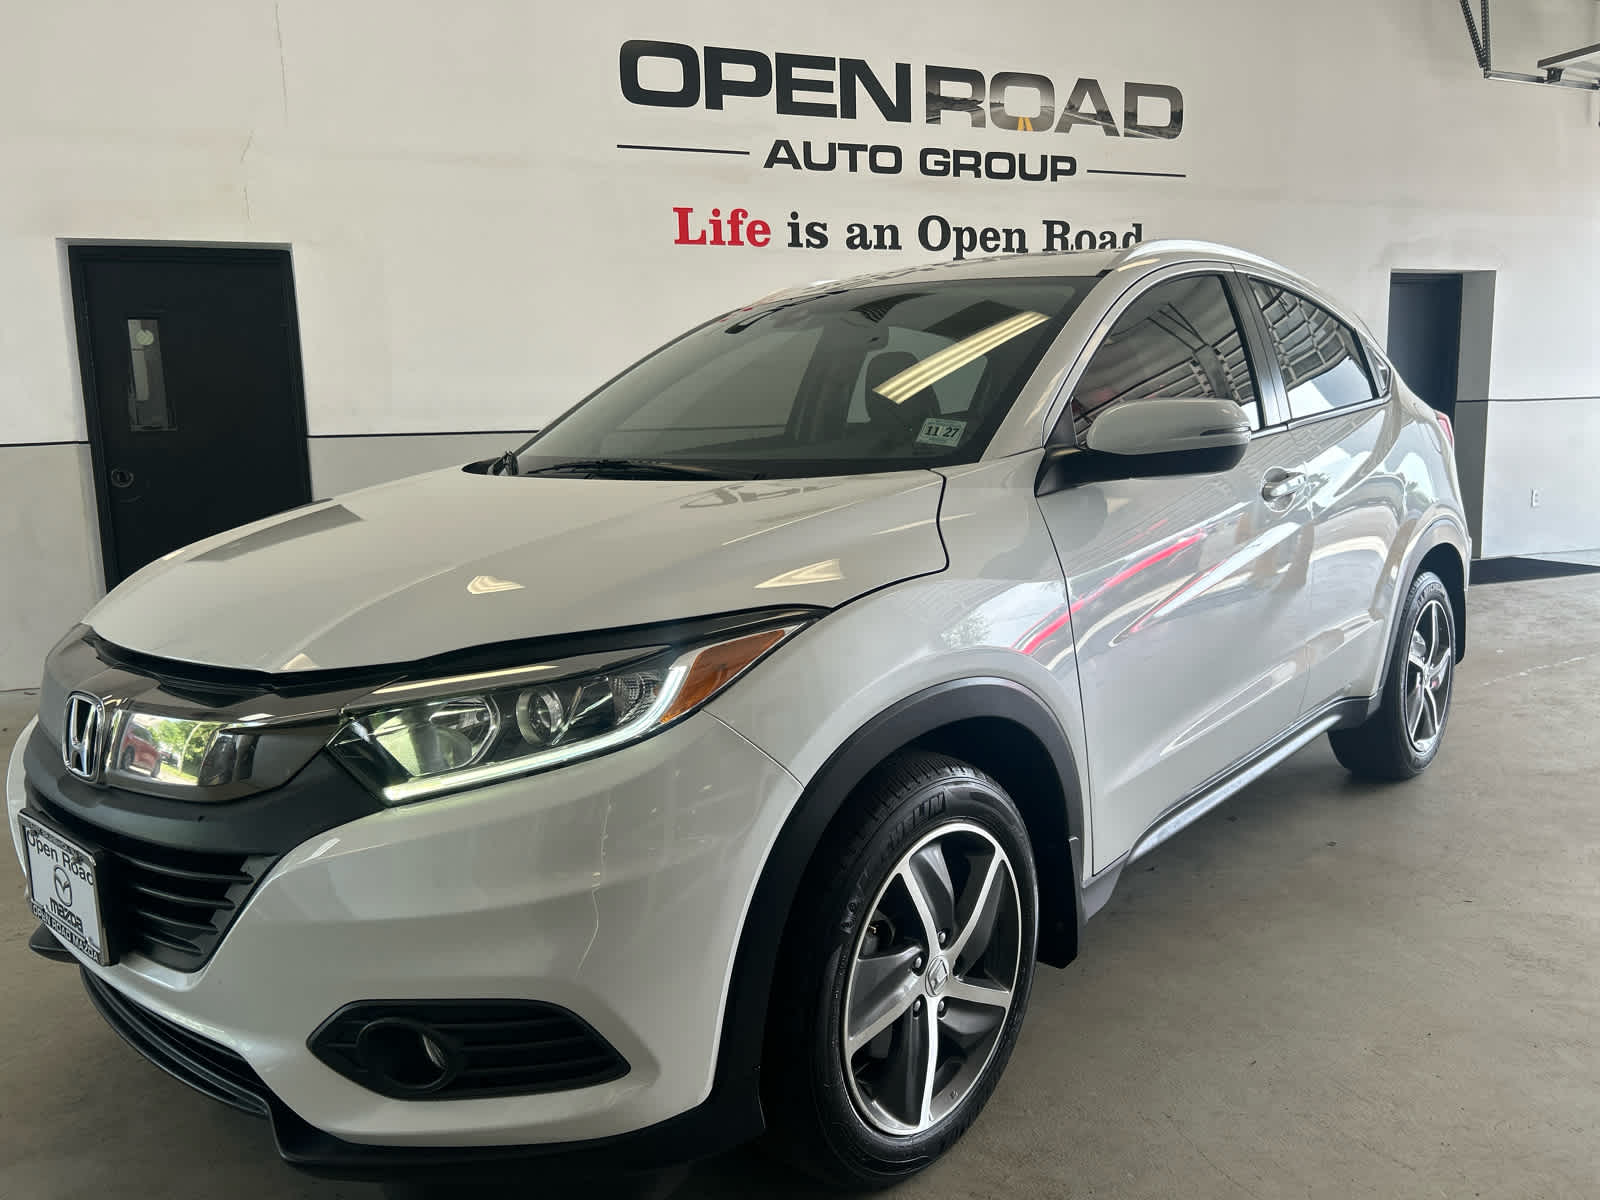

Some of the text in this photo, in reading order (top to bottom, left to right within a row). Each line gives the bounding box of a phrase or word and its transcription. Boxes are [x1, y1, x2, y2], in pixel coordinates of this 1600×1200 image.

[620, 40, 1184, 140] OPEN ROAD
[763, 140, 1077, 183] AUTO GROUP
[672, 207, 1143, 261] Life is an Open Road
[925, 425, 960, 438] 11 27
[26, 829, 59, 863] Open
